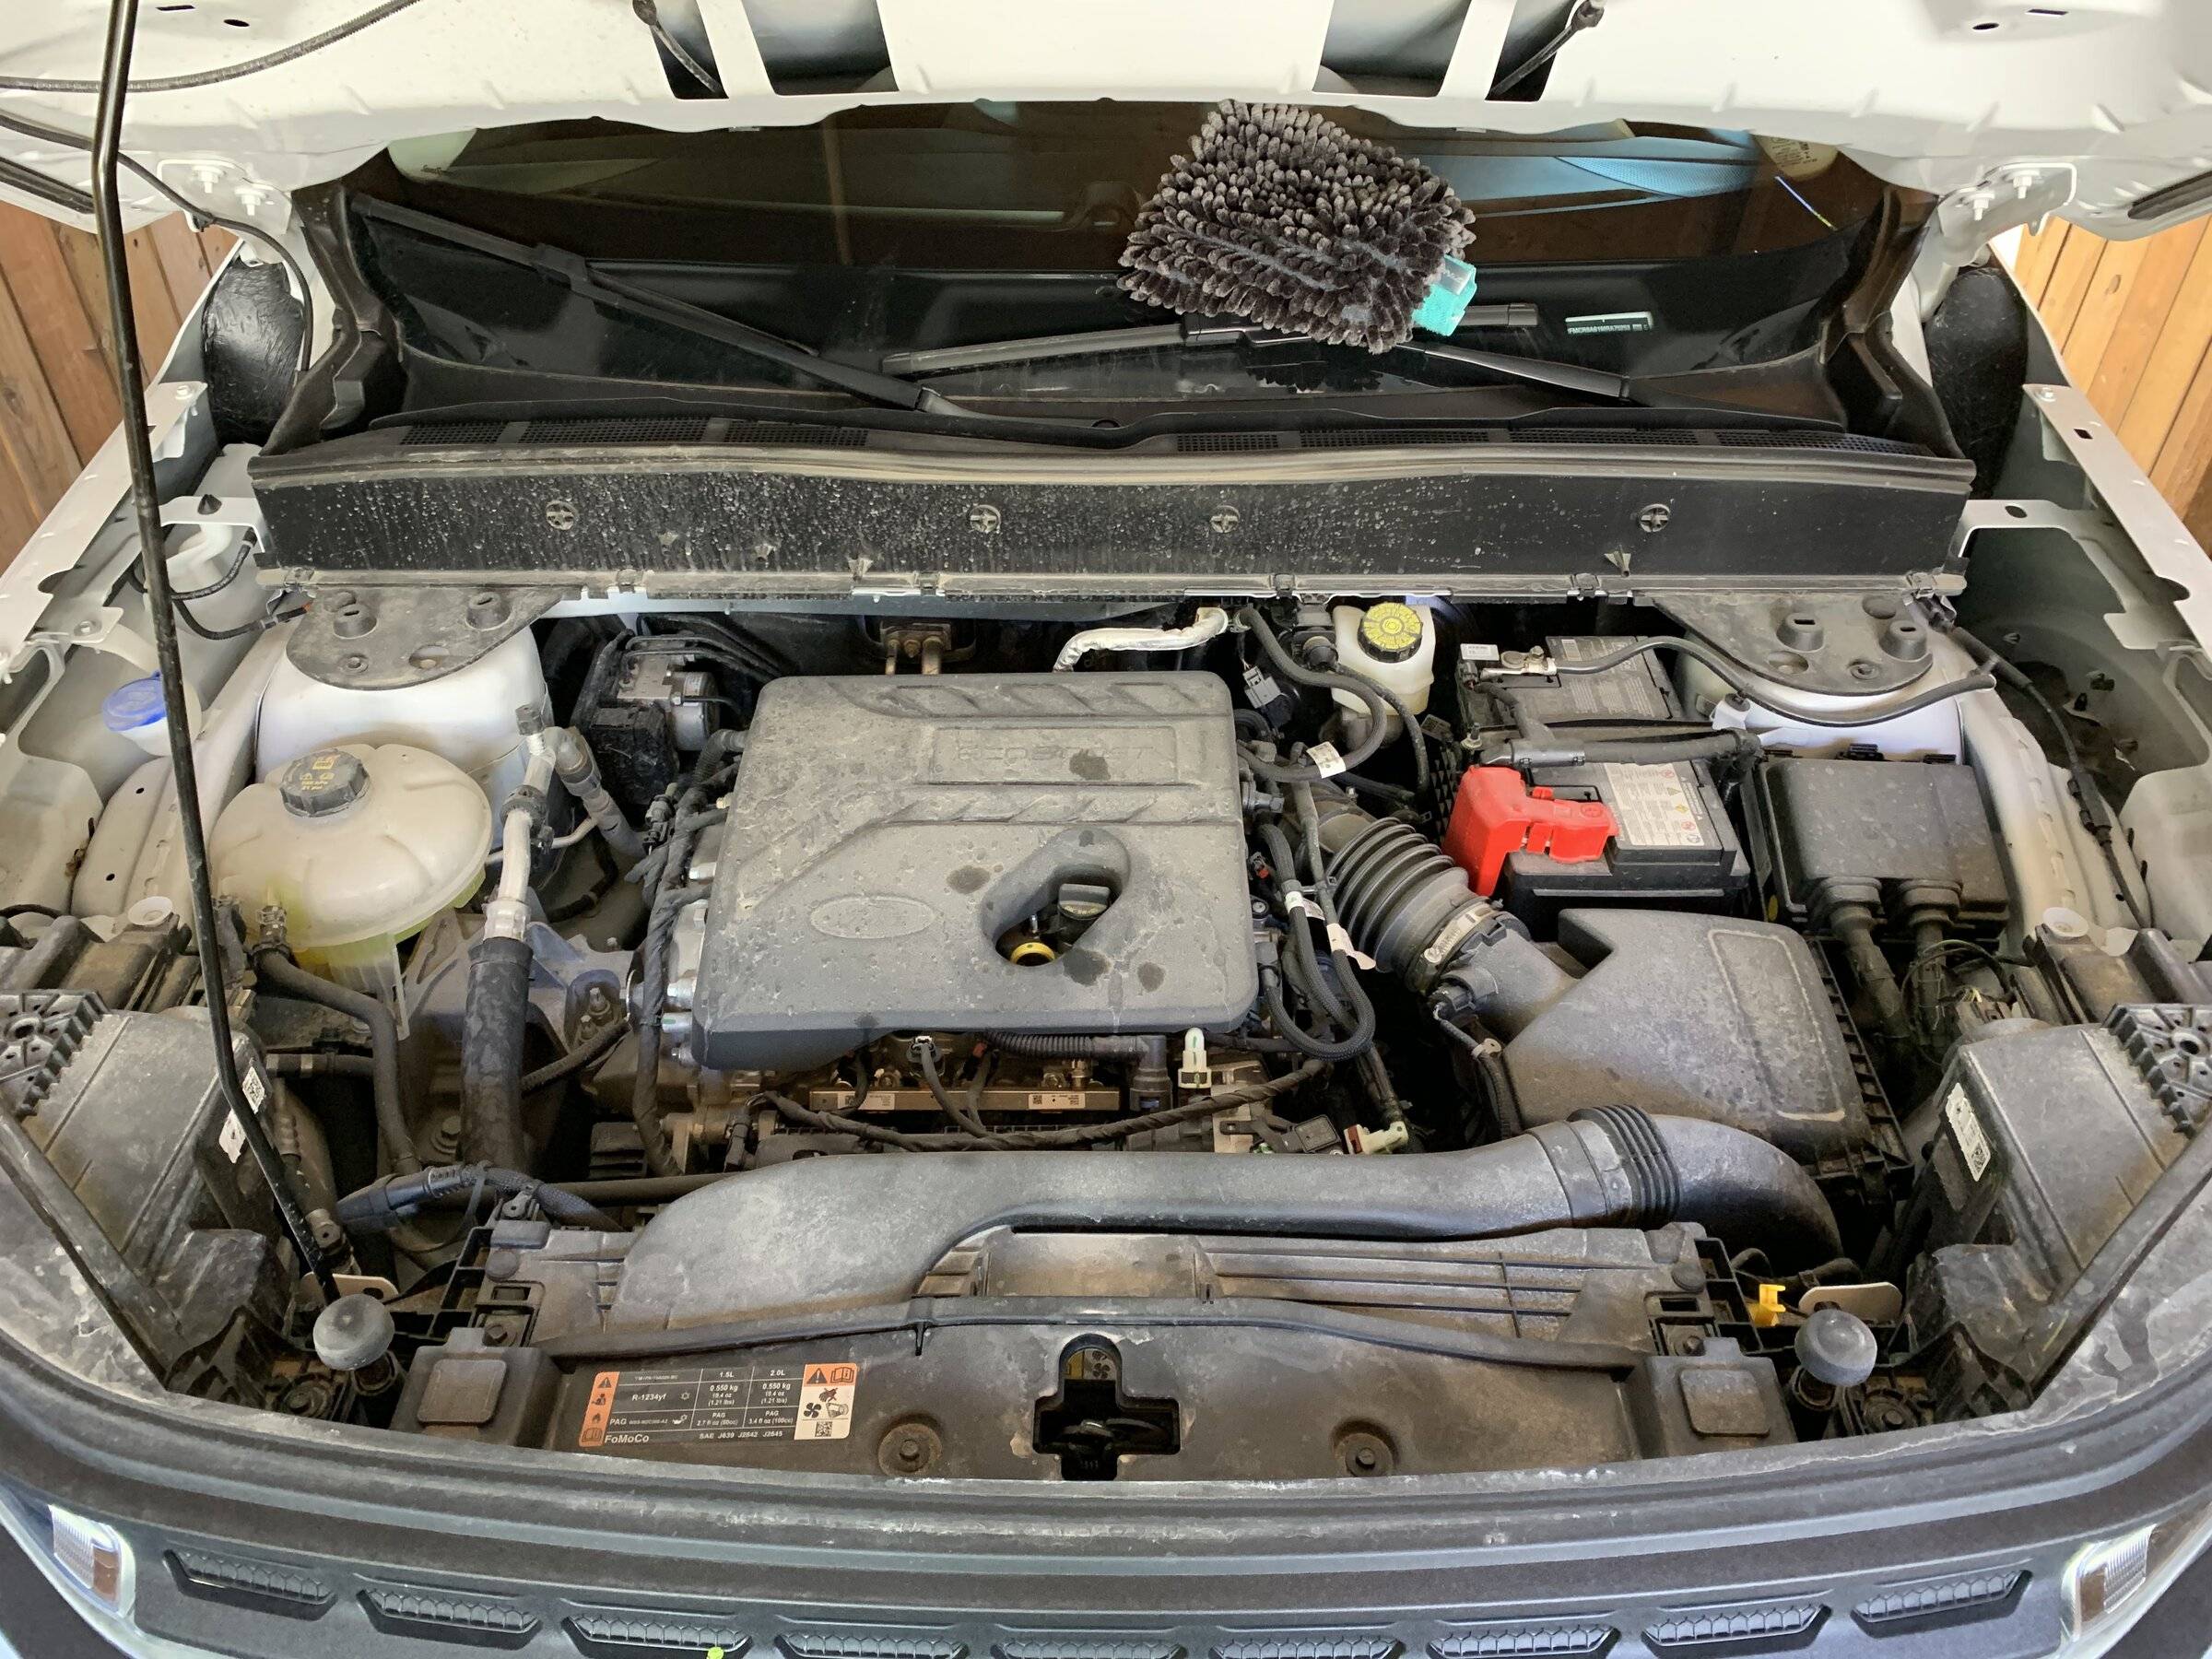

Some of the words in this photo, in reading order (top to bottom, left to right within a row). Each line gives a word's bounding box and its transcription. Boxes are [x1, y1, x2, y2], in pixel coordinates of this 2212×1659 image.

[729, 1384, 739, 1393] kg
[782, 1382, 791, 1391] kg
[631, 1393, 666, 1401] R-1234yf
[604, 1433, 650, 1444] FoMoCo
